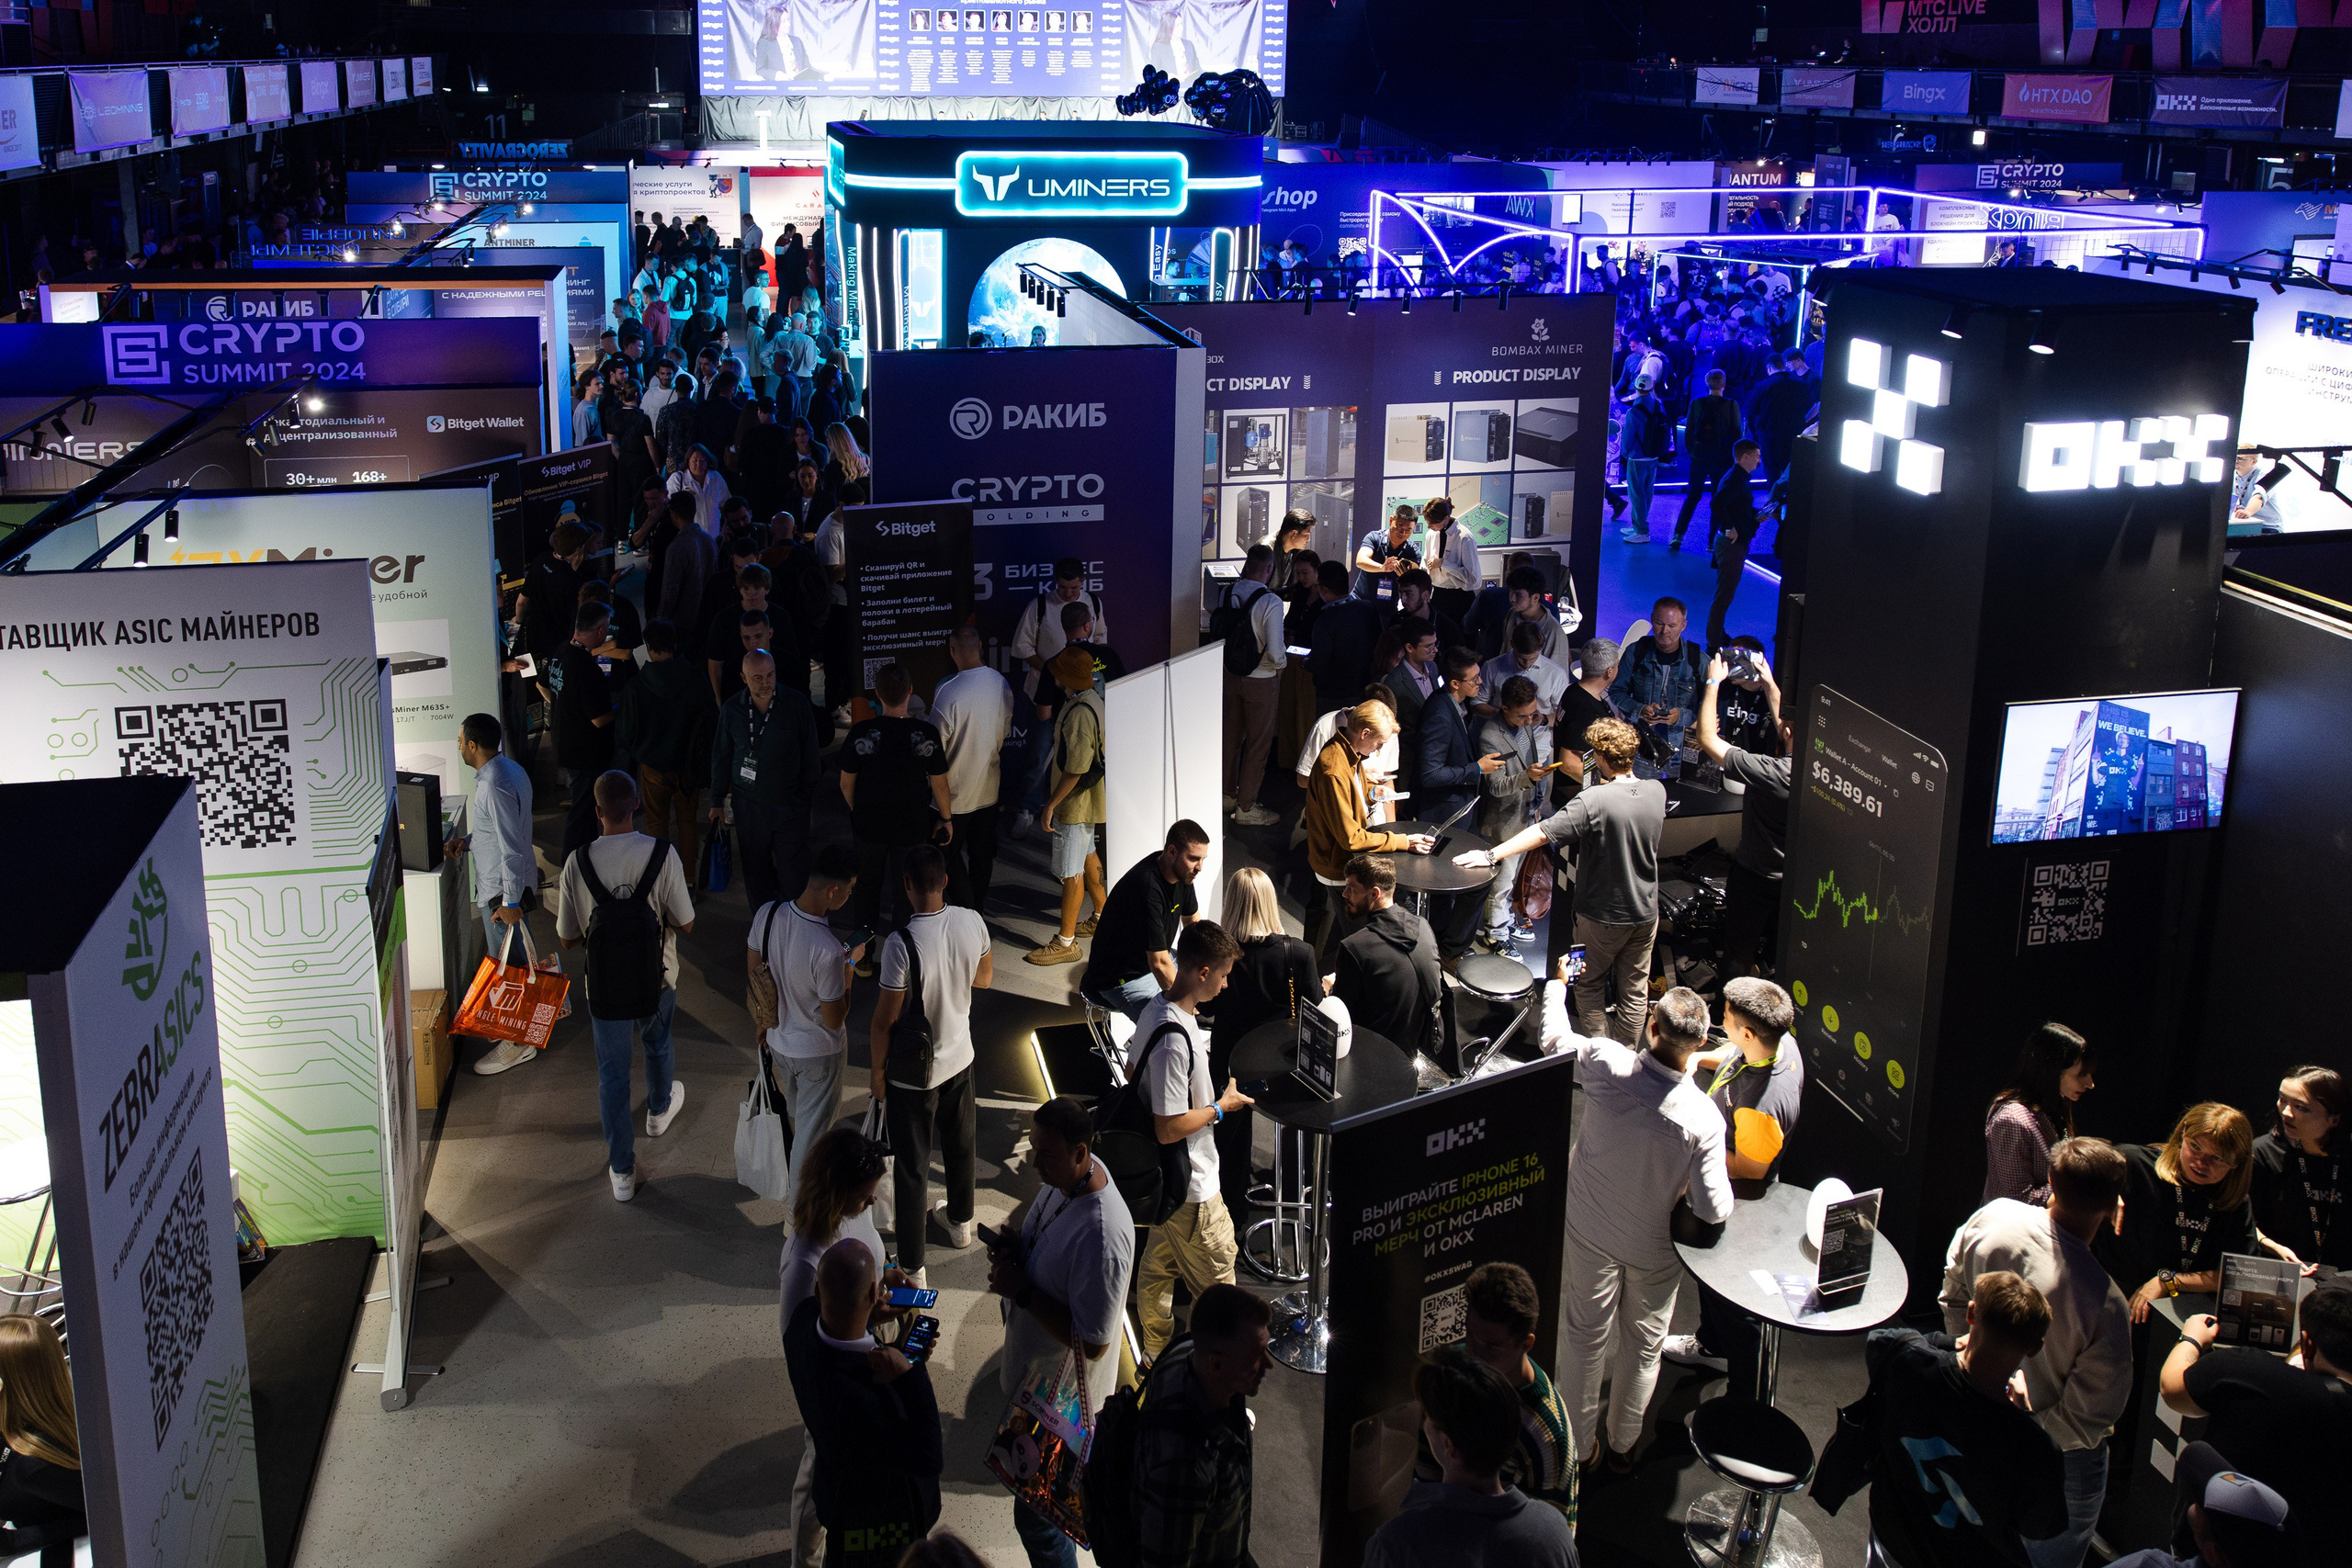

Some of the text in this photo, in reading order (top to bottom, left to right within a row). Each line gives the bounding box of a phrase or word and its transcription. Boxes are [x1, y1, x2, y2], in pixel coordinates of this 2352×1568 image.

[1948, 0, 1986, 15] LIVE
[1906, 17, 1957, 33] ХОЛЛ
[2032, 89, 2093, 105] HTX DAO
[2156, 95, 2197, 110] OKX
[2001, 164, 2064, 177] CRYPTO
[463, 172, 548, 187] CRYPTO
[666, 181, 693, 190] услуги
[2001, 179, 2063, 189] SUMMIT 2024
[640, 189, 706, 197] криптопроектов
[1027, 178, 1171, 197] UMINERS
[464, 190, 548, 201] SUMMIT 2024
[1261, 186, 1317, 209] shop
[483, 238, 536, 246] ANTMINER
[1153, 244, 1163, 271] Easy
[847, 246, 856, 286] Making
[451, 290, 526, 300] НАДЕЖНЫМИ
[243, 300, 314, 318] РАИБ
[179, 321, 365, 355] CRYPTO
[1491, 344, 1583, 356] BOMBAX MINER
[184, 361, 367, 384] SUMMIT 2024
[1453, 367, 1581, 385] PRODUCT DISPLAY
[1228, 376, 1291, 392] DISPLAY
[447, 416, 525, 430] Bitget Wallet
[1003, 402, 1107, 430] РАКИБ
[264, 429, 398, 444] дцентрализованный
[2018, 414, 2229, 492] OKX
[549, 459, 592, 477] Bitget VIP
[593, 471, 608, 480] Bitget
[286, 472, 315, 485] 30+
[352, 470, 388, 484] 168+
[952, 473, 1104, 502] CRYPTO
[504, 496, 522, 506] Bitget
[987, 508, 1091, 521] OLDING
[891, 520, 936, 537] Bitget
[865, 562, 905, 573] Сканируй
[906, 561, 919, 570] QR
[860, 570, 953, 582] скачивай приложение
[861, 583, 885, 593] Bitget
[378, 590, 428, 604] удобной
[866, 598, 901, 608] Заполни
[903, 595, 928, 604] билет
[862, 608, 894, 618] положи
[902, 603, 953, 615] лотерейный
[113, 617, 173, 644] ASIC
[180, 610, 321, 642] МАЙНЕРОВ
[862, 617, 896, 627] барабан
[863, 638, 946, 652] эксклюзивный мерч
[867, 634, 899, 644] Получи
[1820, 695, 1831, 706] 9:41
[422, 704, 450, 713] M63S+
[2101, 704, 2129, 718] THIS IS
[430, 714, 454, 722] 7004W
[2098, 720, 2147, 738] WE BELIEVE.
[1848, 735, 1898, 770] Exchange Wallet
[1825, 746, 1882, 786] Wallet A Account 01
[2109, 766, 2128, 775] OKX
[1812, 760, 1883, 818] $6,389.61
[499, 1016, 527, 1031] MINING
[1821, 1027, 1838, 1044] Receive
[1853, 1055, 1869, 1072] History
[98, 950, 205, 1193] ZEBRASICS
[185, 1066, 212, 1126] аккаунте
[1887, 1086, 1900, 1100] more
[129, 1067, 195, 1211] Больше информации
[1427, 1118, 1486, 1157] OKX
[1363, 1152, 1539, 1224] ВЫИГРАЙТЕ IPHONE 16
[1352, 1166, 1545, 1246] PRO И ЭКСКЛЮЗИВНЫЙ
[1374, 1193, 1523, 1257] МЕРЧ ОТ MCLAREN
[1424, 1228, 1475, 1258] И OKX
[843, 1521, 910, 1552] OKX
